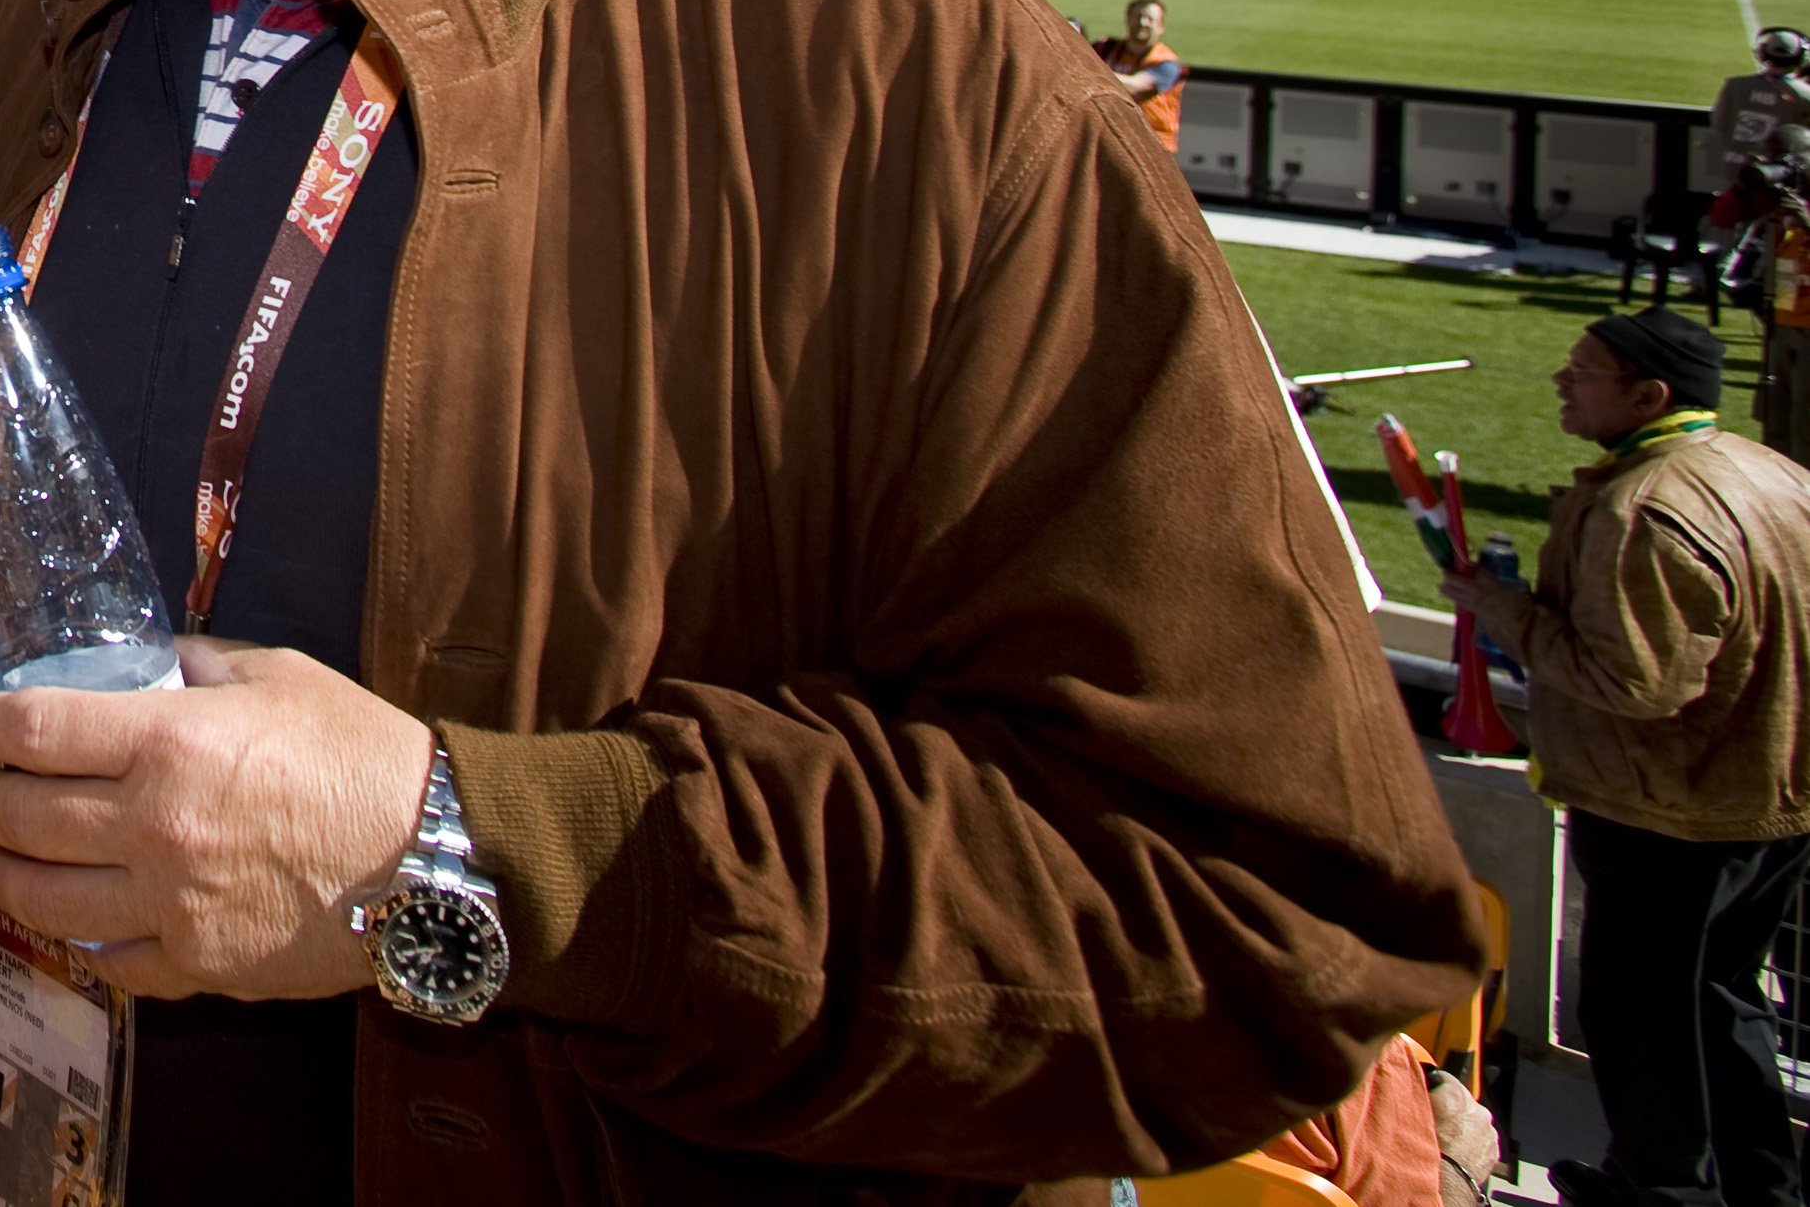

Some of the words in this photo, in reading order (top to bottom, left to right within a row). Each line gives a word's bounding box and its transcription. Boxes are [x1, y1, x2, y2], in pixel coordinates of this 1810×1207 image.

[286, 97, 347, 223] make.believe
[307, 100, 385, 243] SONY
[220, 276, 291, 430] FIFA.com
[14, 923, 59, 963] AFRICA
[5, 951, 32, 980] NAPEL
[24, 1009, 44, 1032] (NED)
[65, 1122, 86, 1166] 3
